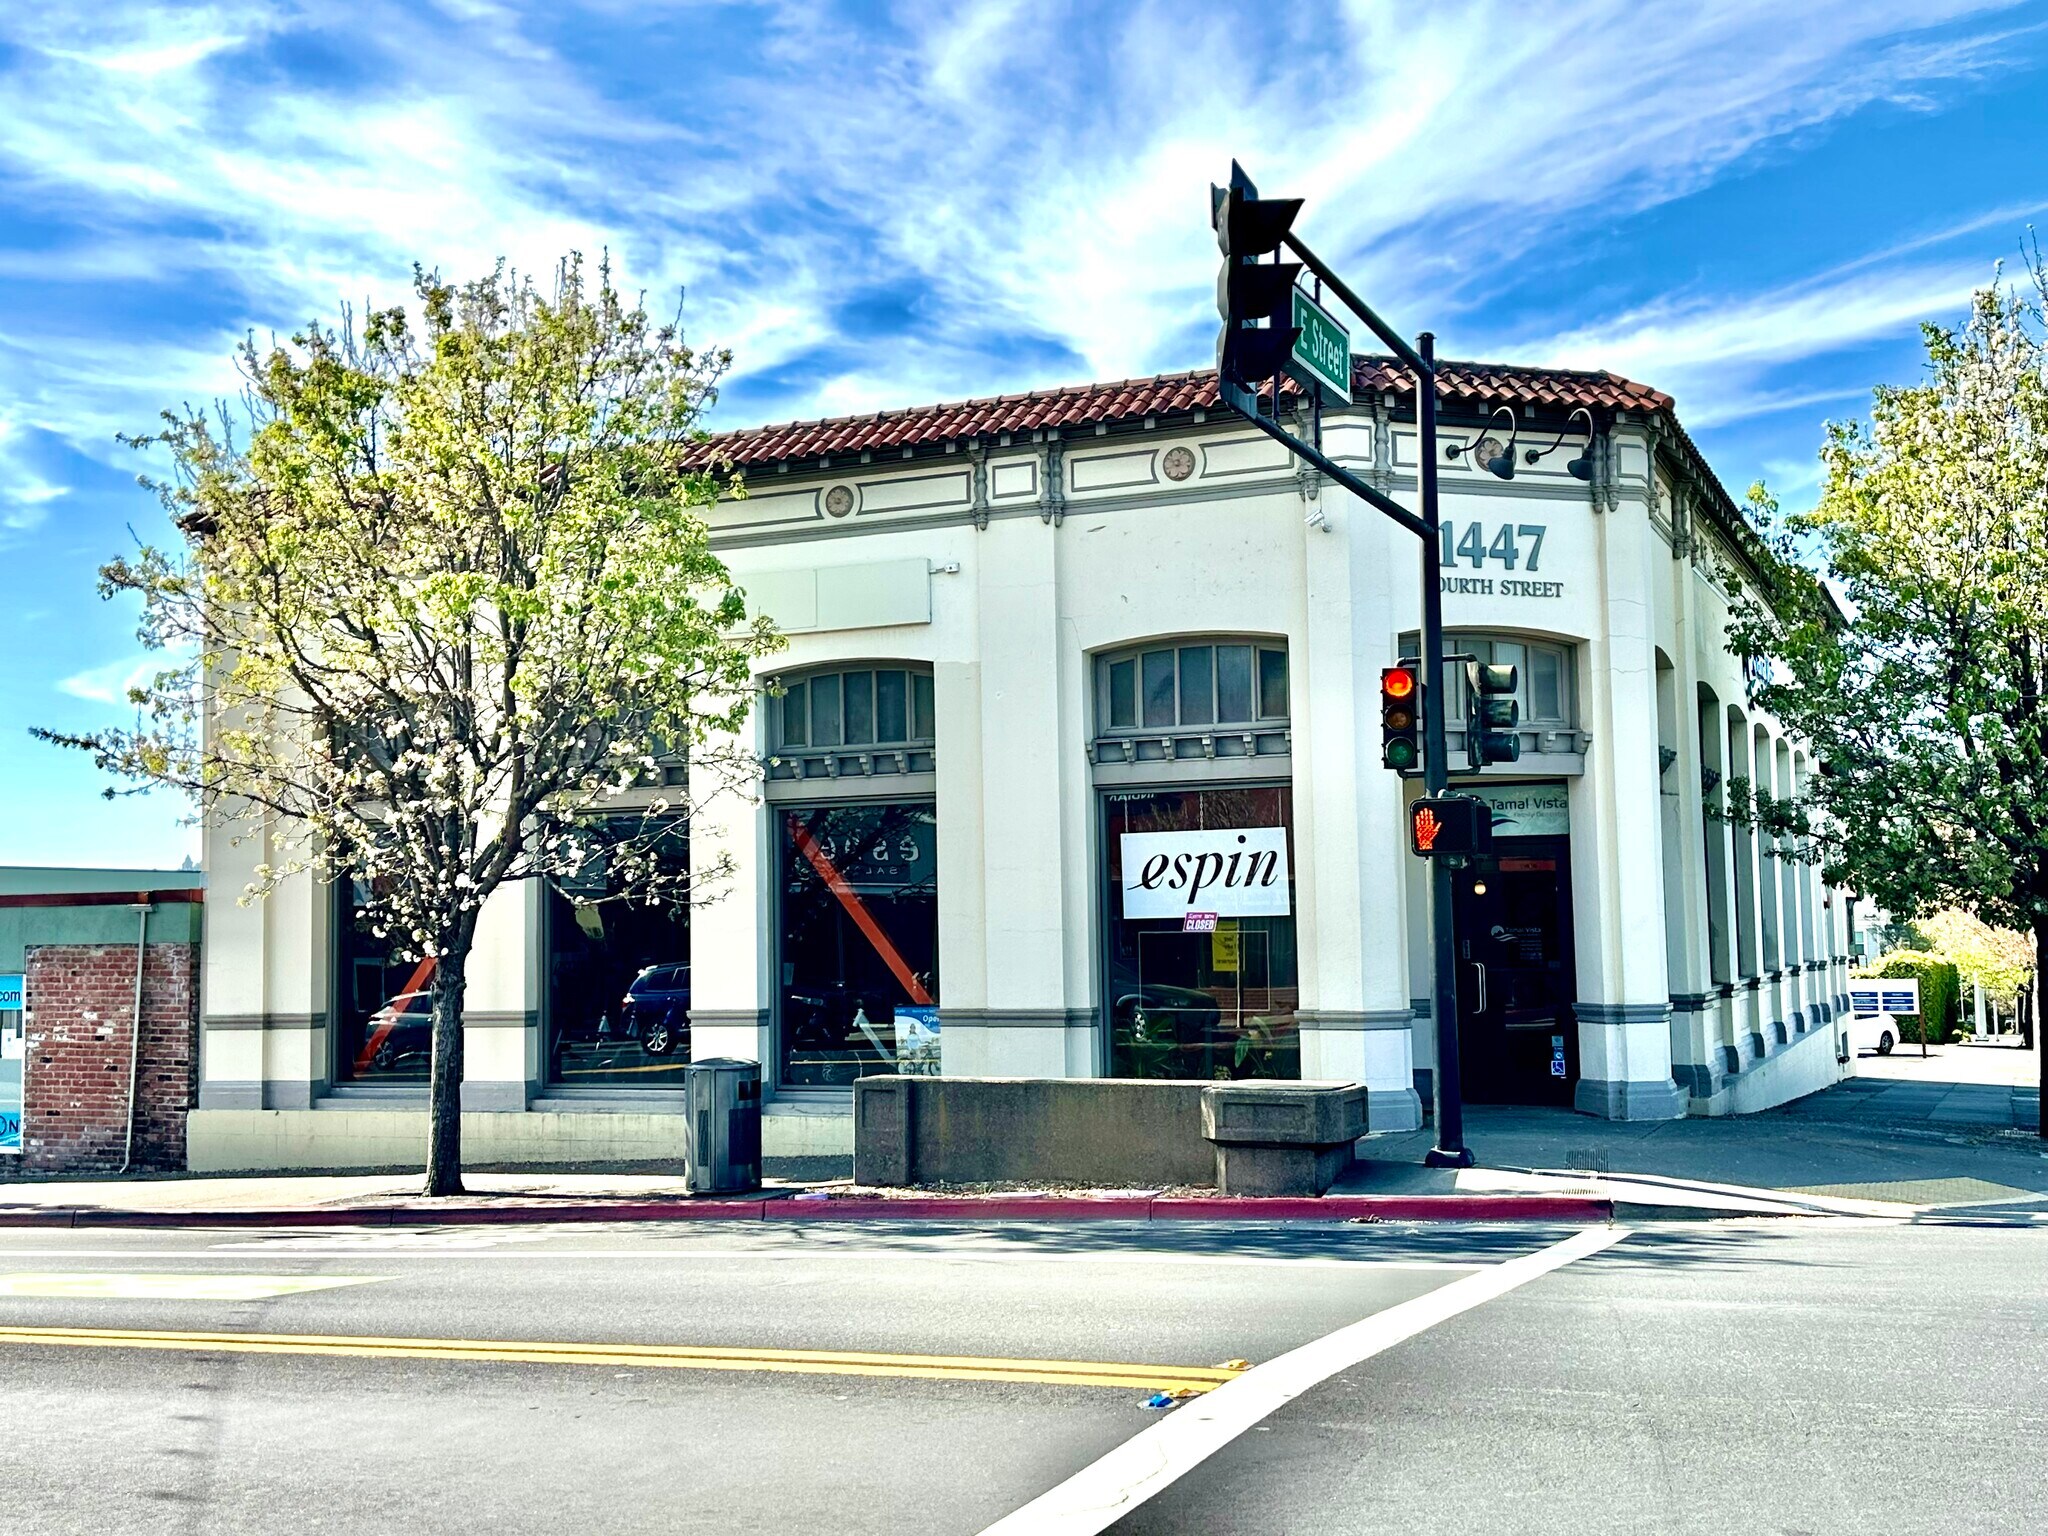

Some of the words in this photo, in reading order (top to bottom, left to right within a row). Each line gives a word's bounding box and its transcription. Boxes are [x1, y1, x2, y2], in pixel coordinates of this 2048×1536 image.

[1300, 307, 1308, 350] E
[1312, 318, 1344, 380] Street
[1438, 520, 1547, 572] 1447
[1439, 576, 1494, 595] OURTH
[1500, 579, 1564, 598] STREET
[1489, 797, 1529, 811] Tamal
[1533, 796, 1567, 810] Vista
[1127, 834, 1279, 905] espin
[1185, 919, 1215, 930] CLOSED
